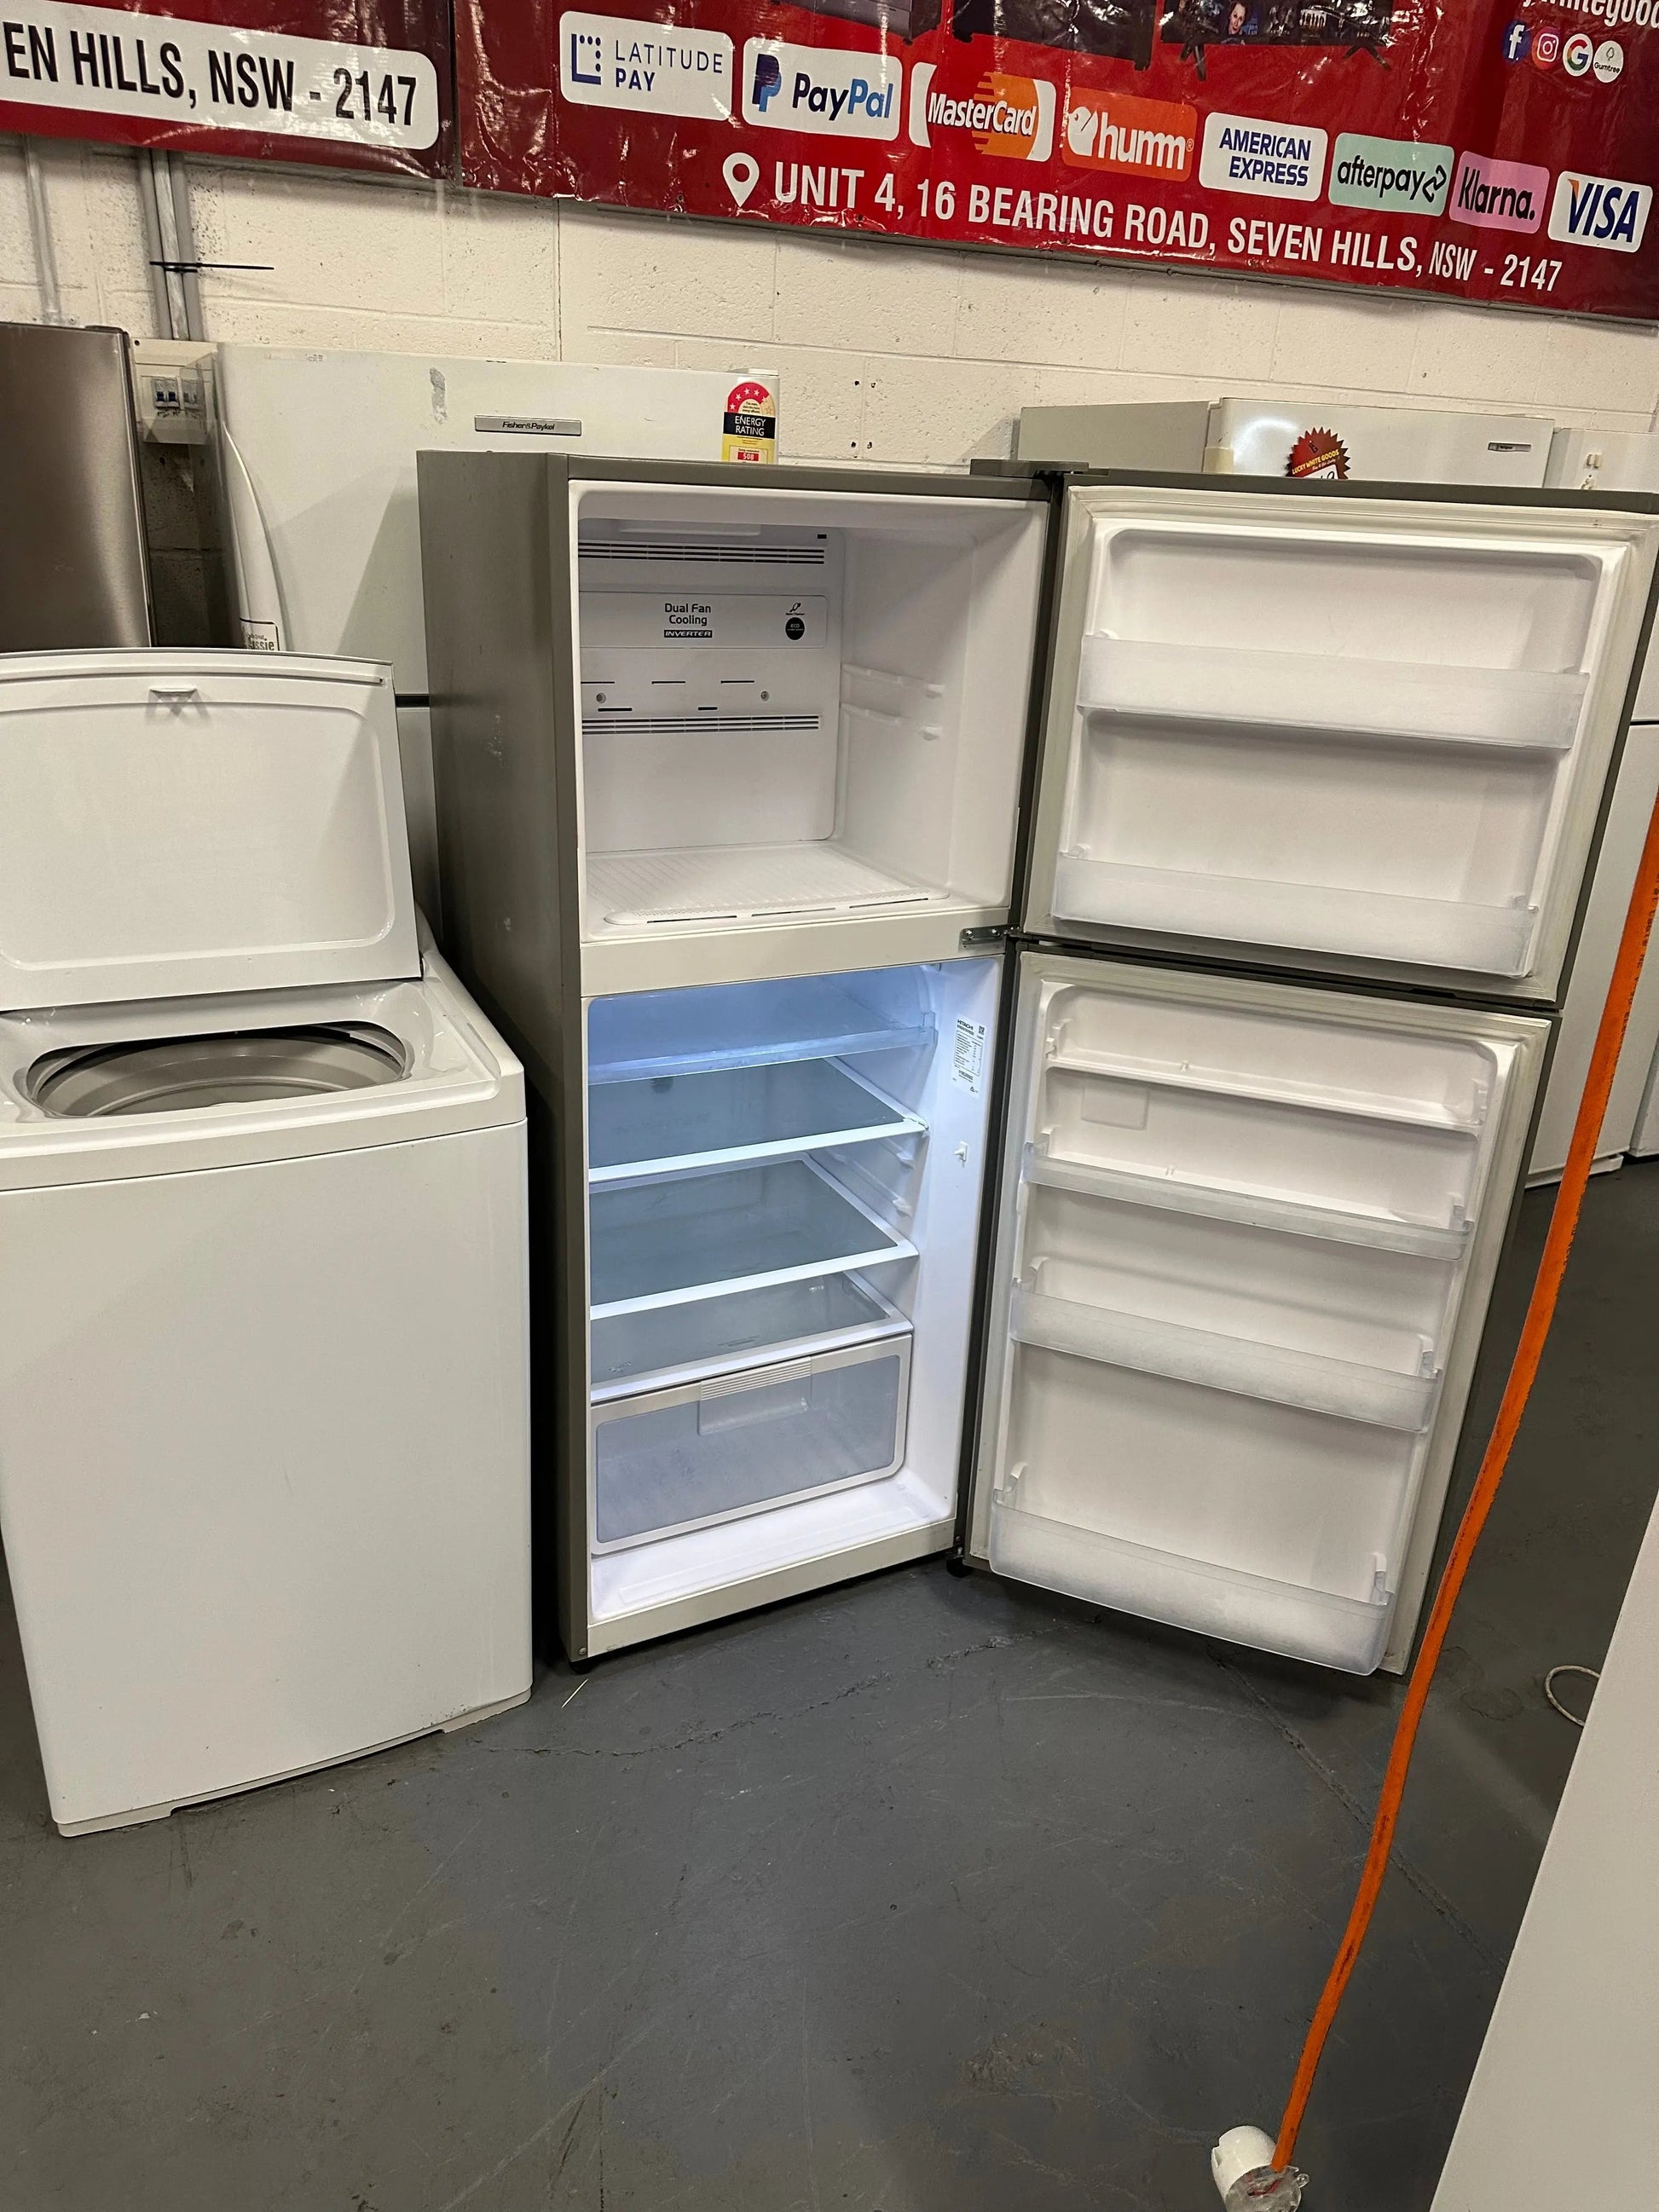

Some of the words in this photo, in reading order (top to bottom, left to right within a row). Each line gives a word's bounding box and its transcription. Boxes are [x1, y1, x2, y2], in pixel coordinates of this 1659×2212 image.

[616, 40, 723, 73] LATITUDE
[1594, 61, 1621, 74] Gumtree
[3, 22, 57, 82] EN
[70, 30, 197, 108] HILLS,
[208, 49, 294, 111] NSW
[309, 90, 321, 101] -
[332, 67, 417, 126] 2147
[616, 68, 656, 92] PAY
[792, 72, 894, 121] PayPal
[927, 91, 1038, 137] MasterCard
[1219, 128, 1312, 161] AMERICAN
[1228, 155, 1309, 187] EXPRESS
[1337, 154, 1427, 201] afterpay
[1459, 166, 1535, 221] Klarna.
[774, 161, 864, 209] UNIT
[874, 173, 905, 220] 4,
[917, 178, 955, 221] 16
[968, 184, 1113, 238] BEARING
[1124, 204, 1216, 255] ROAD,
[1228, 217, 1321, 262] SEVEN
[1330, 229, 1423, 278] HILLS,
[1428, 241, 1477, 281] NSW
[1484, 267, 1494, 276] -
[1500, 254, 1563, 292] 2147
[1568, 178, 1642, 244] VISA
[502, 421, 555, 431] Fisher&Paykel
[734, 415, 766, 427] ENERGY
[735, 425, 765, 436] RATING
[1321, 449, 1339, 461] GOODS
[664, 603, 689, 613] Dual
[691, 604, 711, 613] Fan
[668, 615, 708, 627] Cooling
